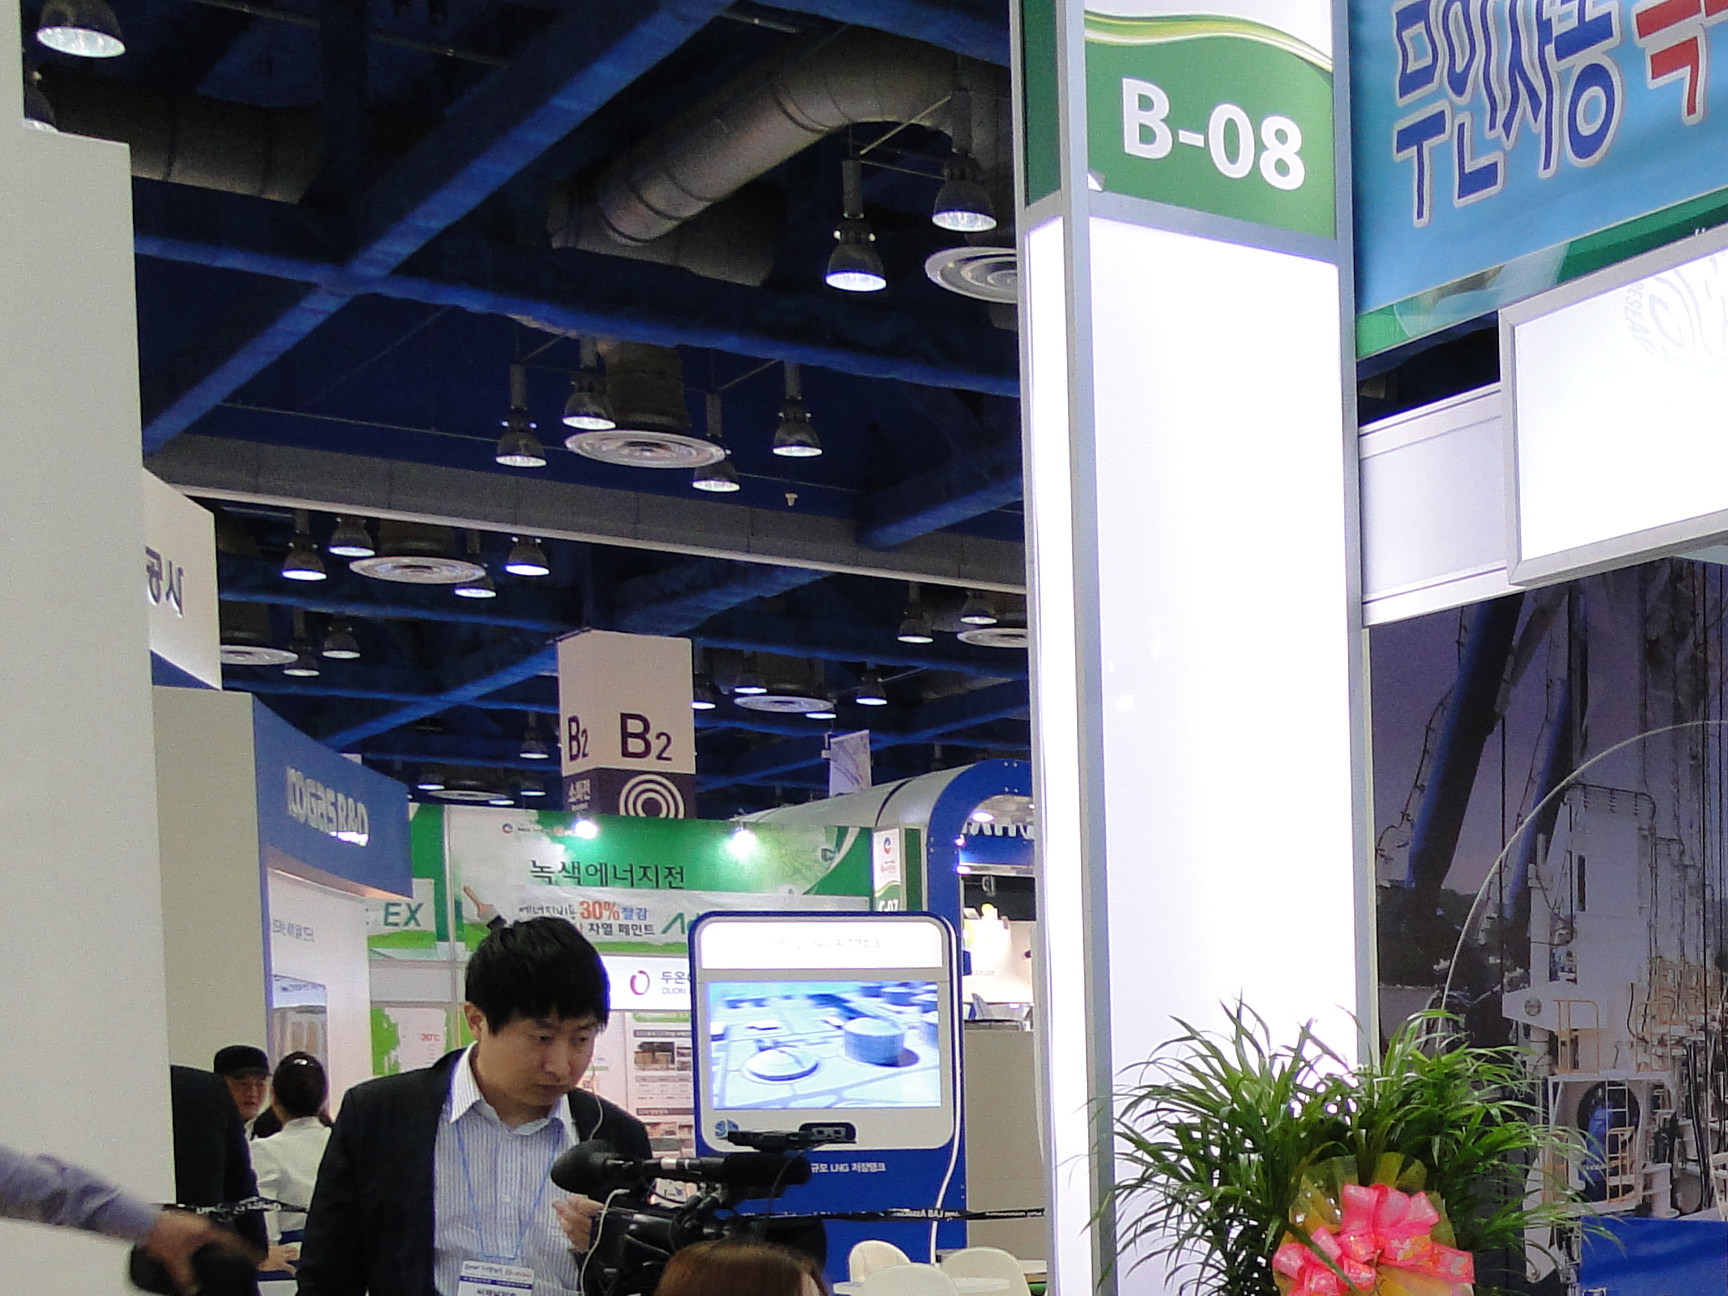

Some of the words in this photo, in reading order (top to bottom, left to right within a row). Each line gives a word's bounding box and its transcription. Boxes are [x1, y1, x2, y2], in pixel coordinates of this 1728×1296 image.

[1122, 78, 1305, 190] B-08
[567, 716, 589, 761] B2
[620, 712, 673, 761] B2
[530, 860, 686, 890] 녹색에너지전
